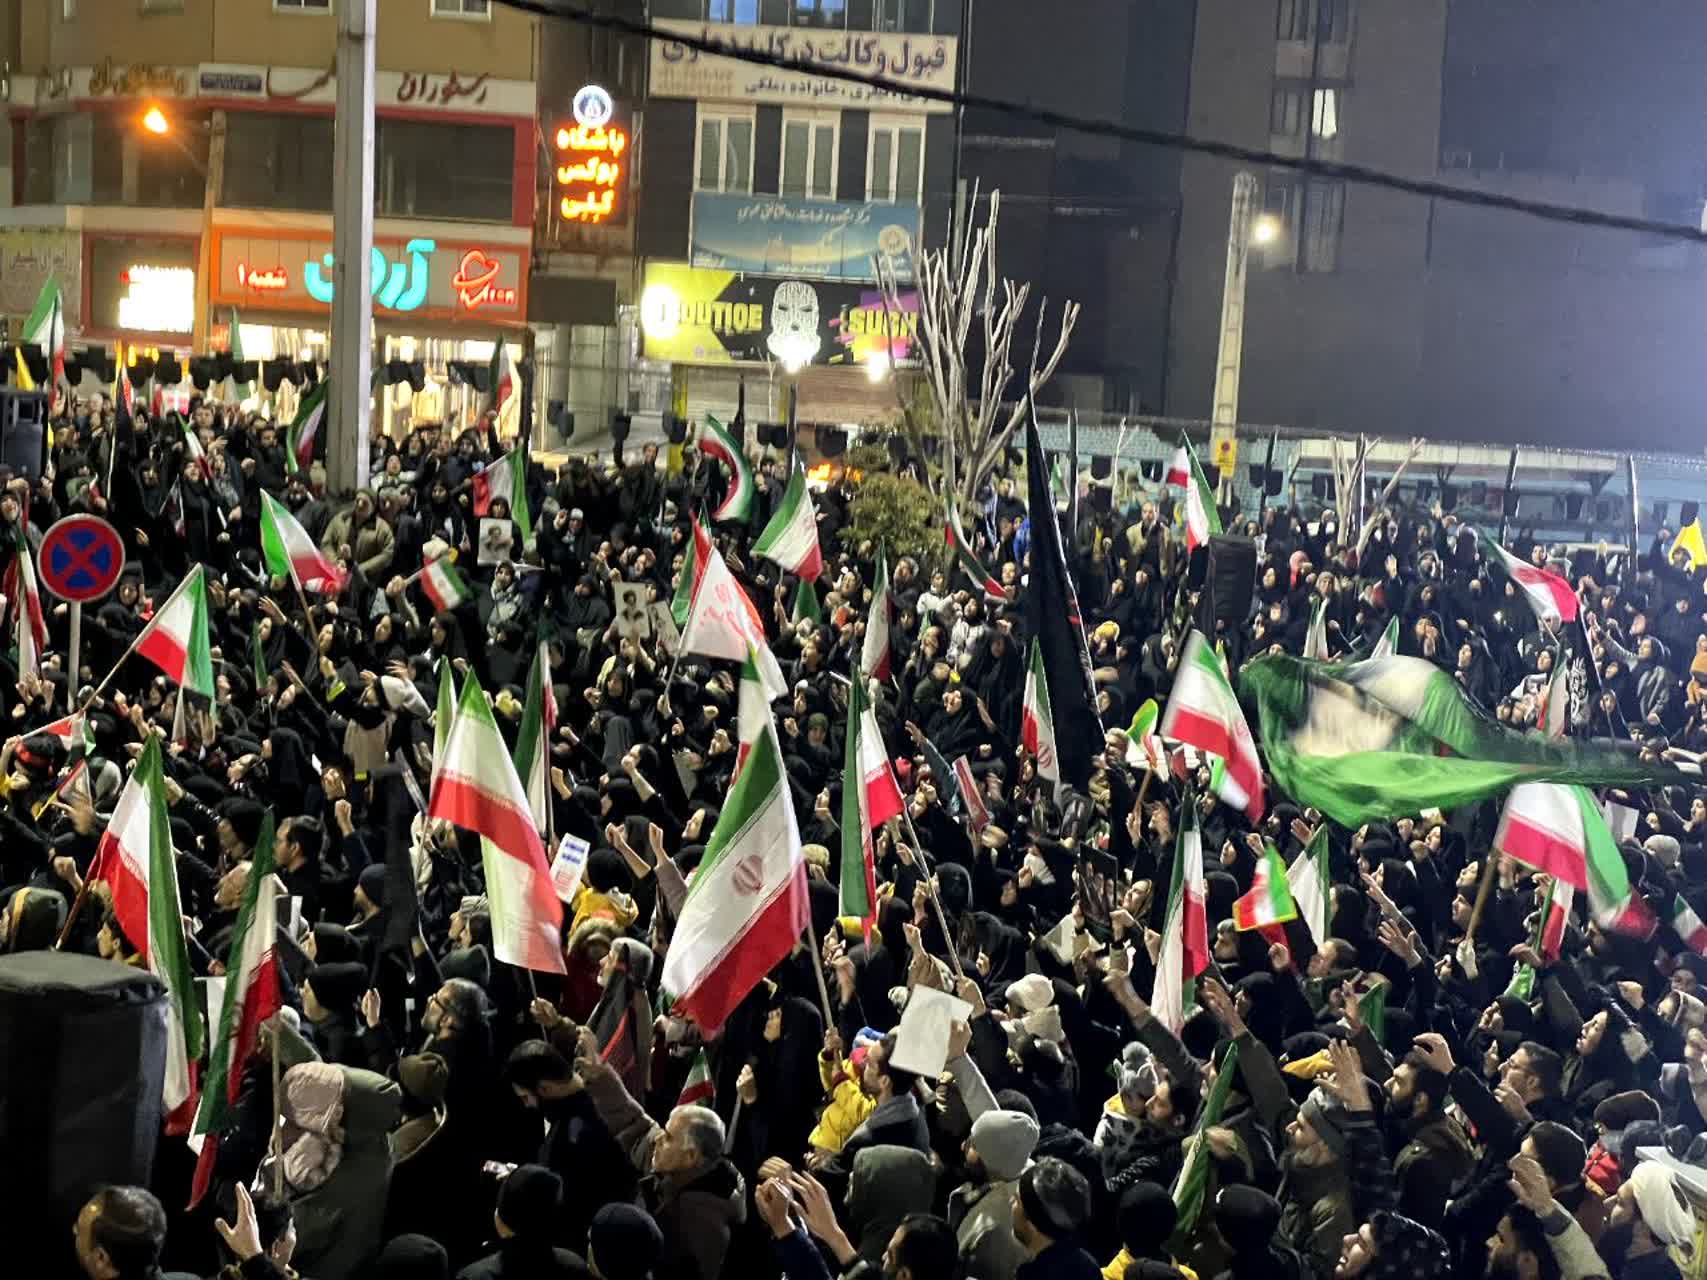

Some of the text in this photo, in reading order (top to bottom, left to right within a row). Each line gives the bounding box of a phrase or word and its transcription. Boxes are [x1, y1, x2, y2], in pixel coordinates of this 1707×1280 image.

[891, 38, 946, 79] قبول
[556, 123, 625, 158] باشگاه
[557, 156, 619, 187] بوکس
